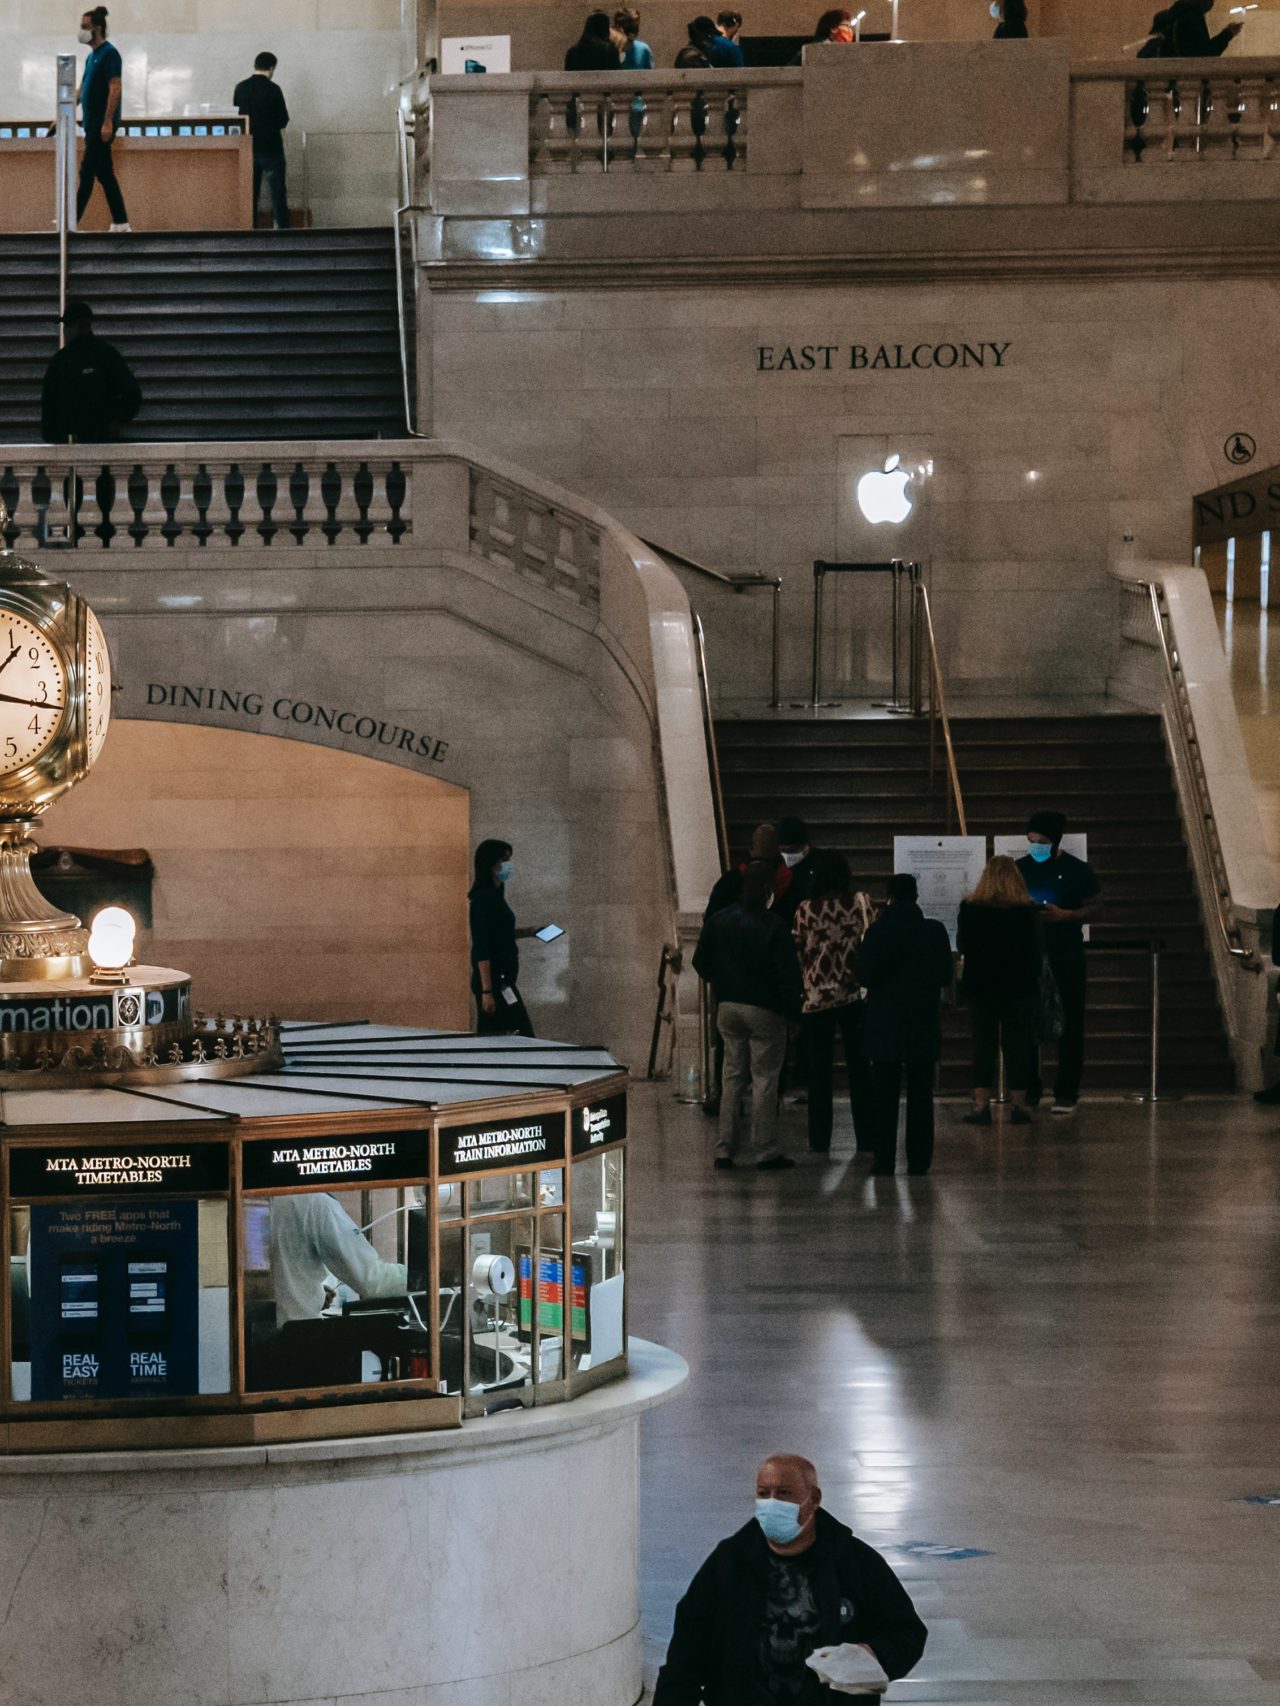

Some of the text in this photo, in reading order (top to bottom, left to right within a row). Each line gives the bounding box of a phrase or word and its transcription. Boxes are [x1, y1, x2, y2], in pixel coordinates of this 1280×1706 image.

[757, 342, 1011, 371] EAST BALCONY
[8, 628, 15, 649] 1
[29, 647, 41, 669] 2
[37, 681, 48, 705] 3
[27, 714, 41, 734] 4
[146, 683, 449, 763] DINING CONCOURSE
[5, 736, 18, 758] 5
[457, 1125, 542, 1149] MTA METRO-NORTH
[272, 1142, 395, 1163] MTA METRO-NORTH
[453, 1139, 546, 1163] TRAIN INFORMATION
[45, 1155, 191, 1171] MTA METRO-NORTH
[297, 1159, 372, 1175] TIMETABLES
[75, 1170, 163, 1185] TIMETABLES
[60, 1211, 81, 1221] Two
[85, 1210, 116, 1220] FREE
[149, 1210, 170, 1219] that
[49, 1223, 79, 1233] make
[82, 1222, 112, 1234] riding
[100, 1234, 136, 1243] breeze
[63, 1353, 99, 1366] REAL
[130, 1352, 167, 1364] REAL
[63, 1366, 99, 1379] EASY
[130, 1364, 167, 1377] TIME
